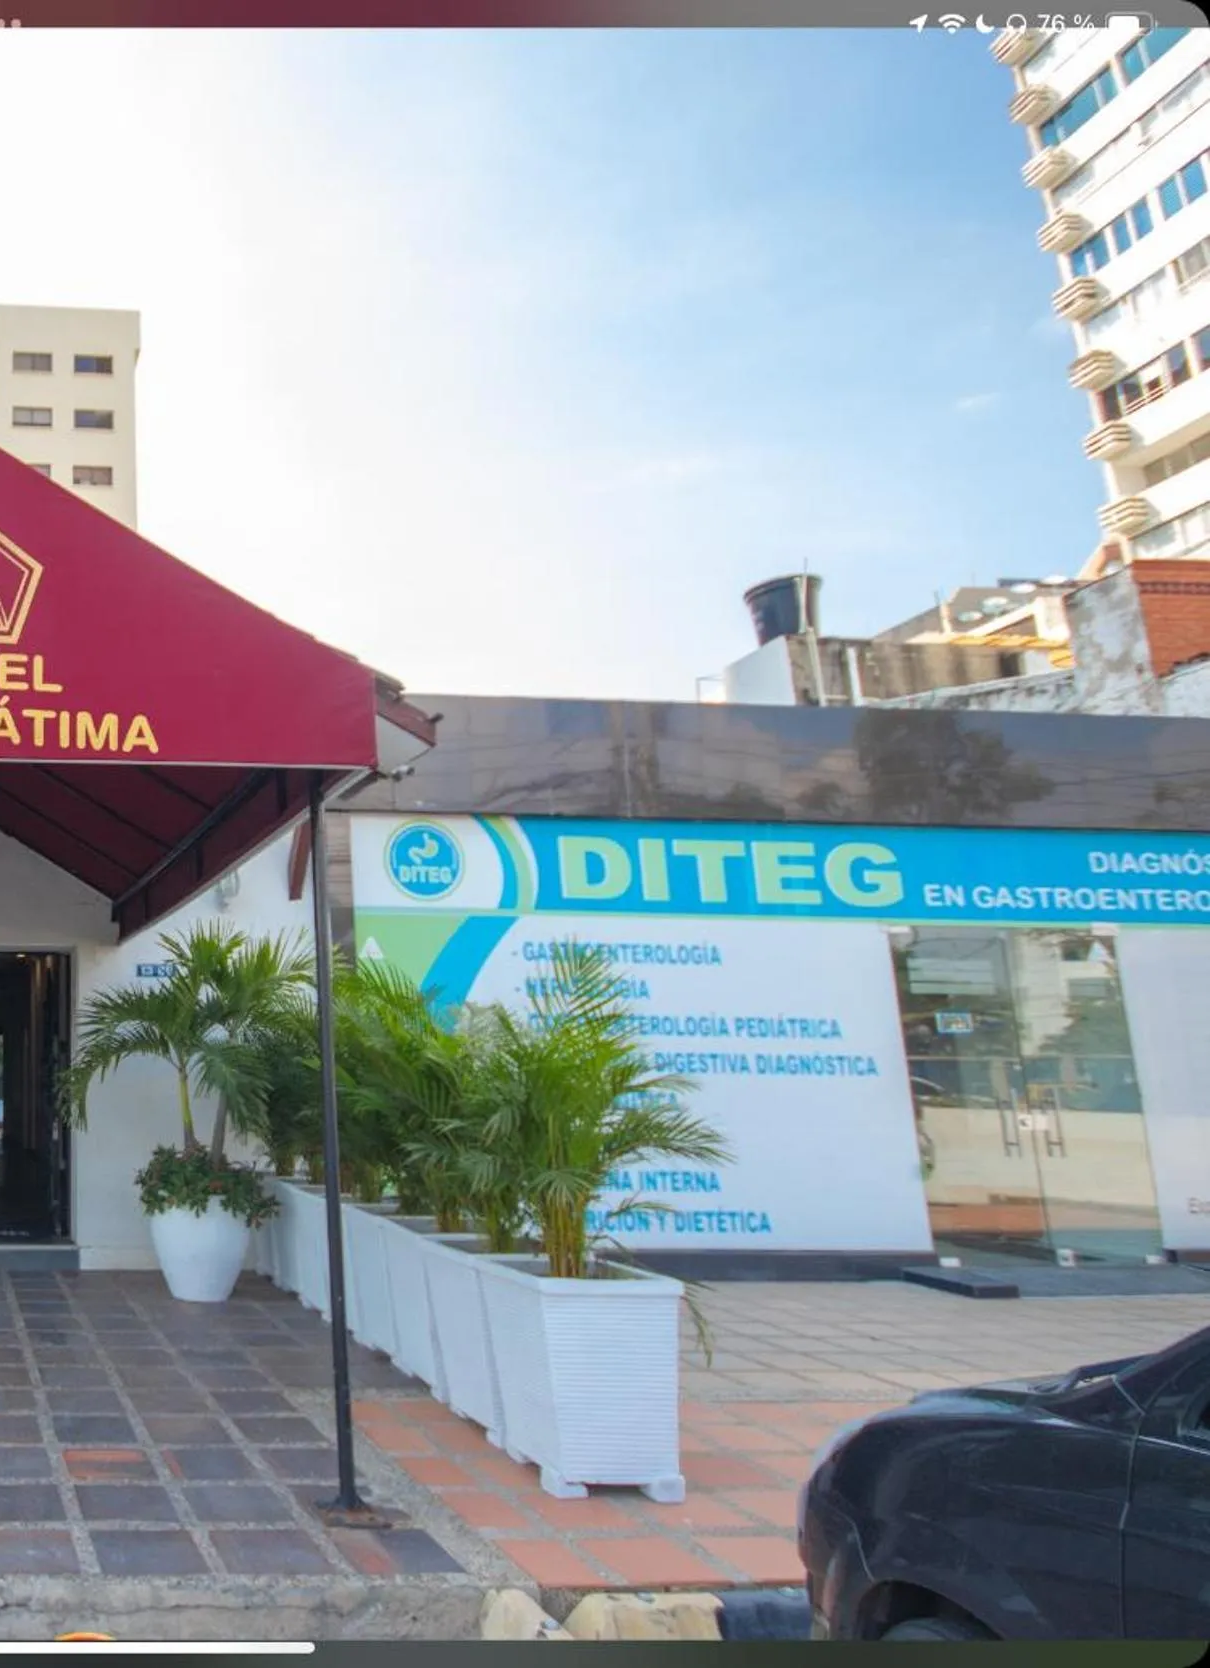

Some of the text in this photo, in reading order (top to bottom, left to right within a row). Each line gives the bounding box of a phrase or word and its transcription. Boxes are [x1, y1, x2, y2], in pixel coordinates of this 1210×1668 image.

[398, 865, 452, 884] DITEG
[557, 834, 905, 908] DITEG
[923, 884, 1210, 913] EN GASTROENTERO
[734, 1012, 843, 1039] PEDIÁTRICA
[654, 1052, 751, 1074] DIGESTIVA
[640, 1171, 722, 1192] INTERNA
[657, 1209, 668, 1233] Y
[674, 1207, 772, 1233] DIETÉTICA
